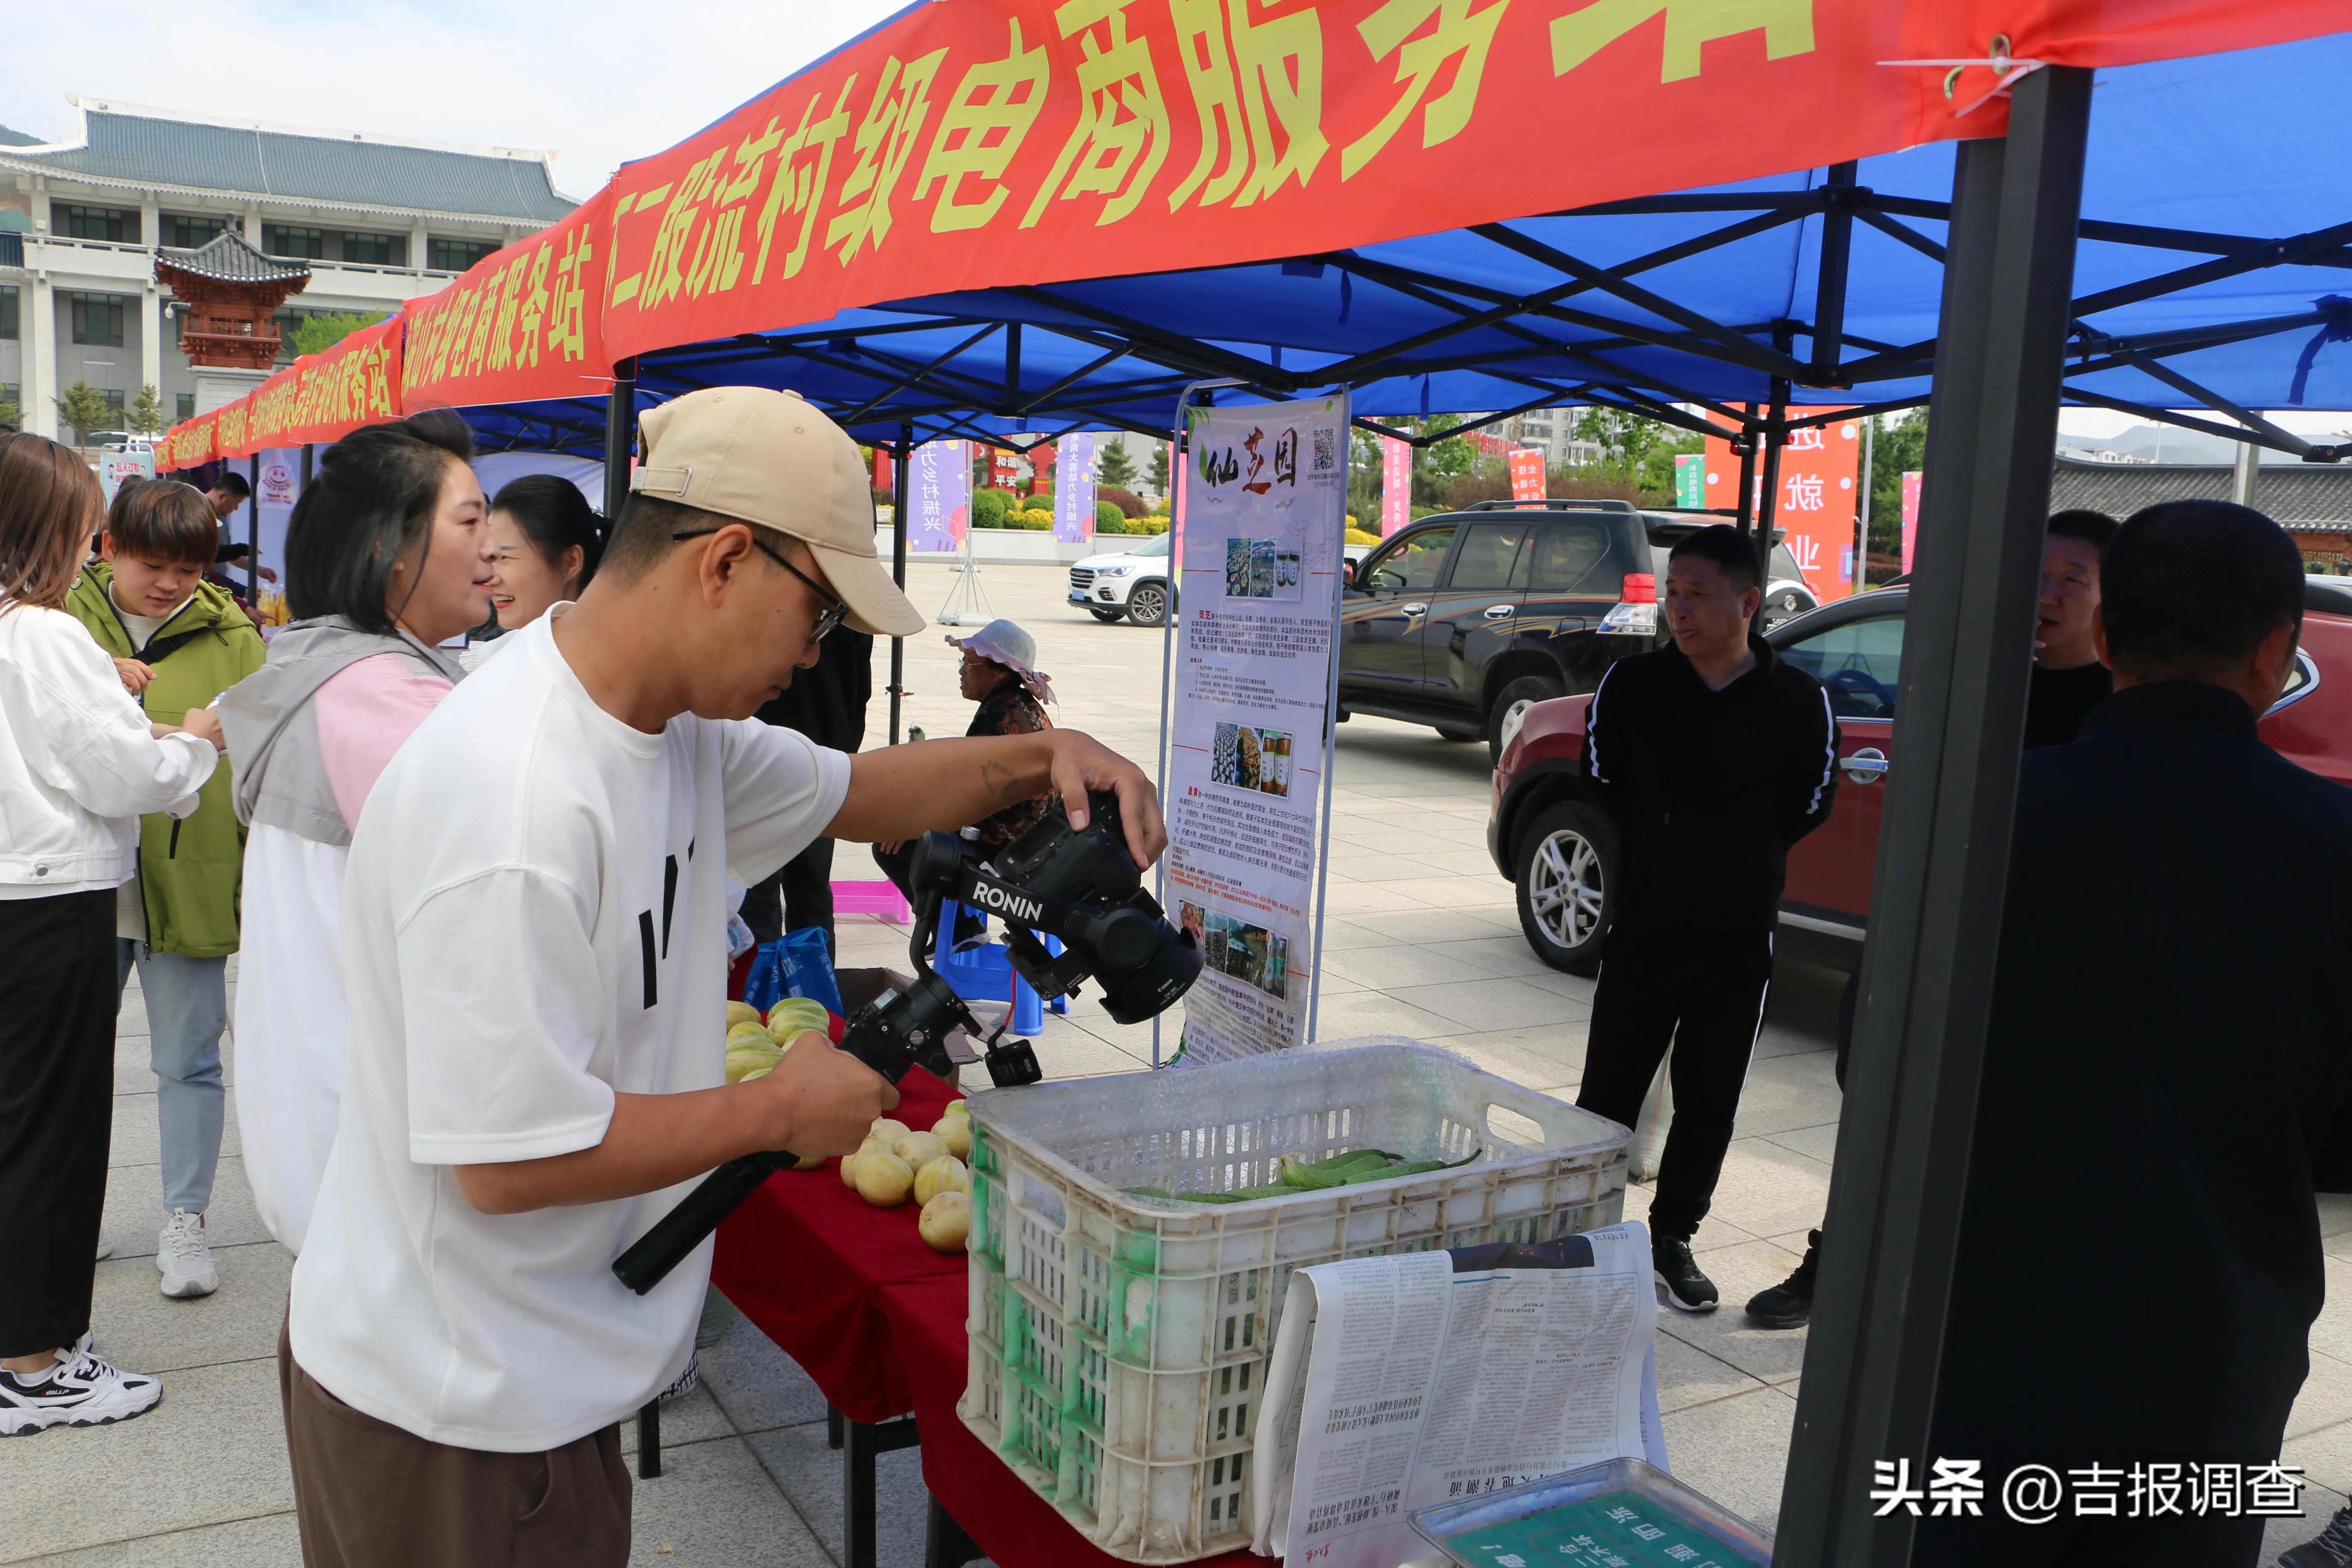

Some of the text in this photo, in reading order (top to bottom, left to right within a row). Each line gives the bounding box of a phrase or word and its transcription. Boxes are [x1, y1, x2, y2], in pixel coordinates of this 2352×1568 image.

[995, 456, 1017, 469] 和谐
[995, 475, 1017, 487] 平安
[973, 881, 1043, 922] RONIN
[1158, 978, 1173, 992] Canon
